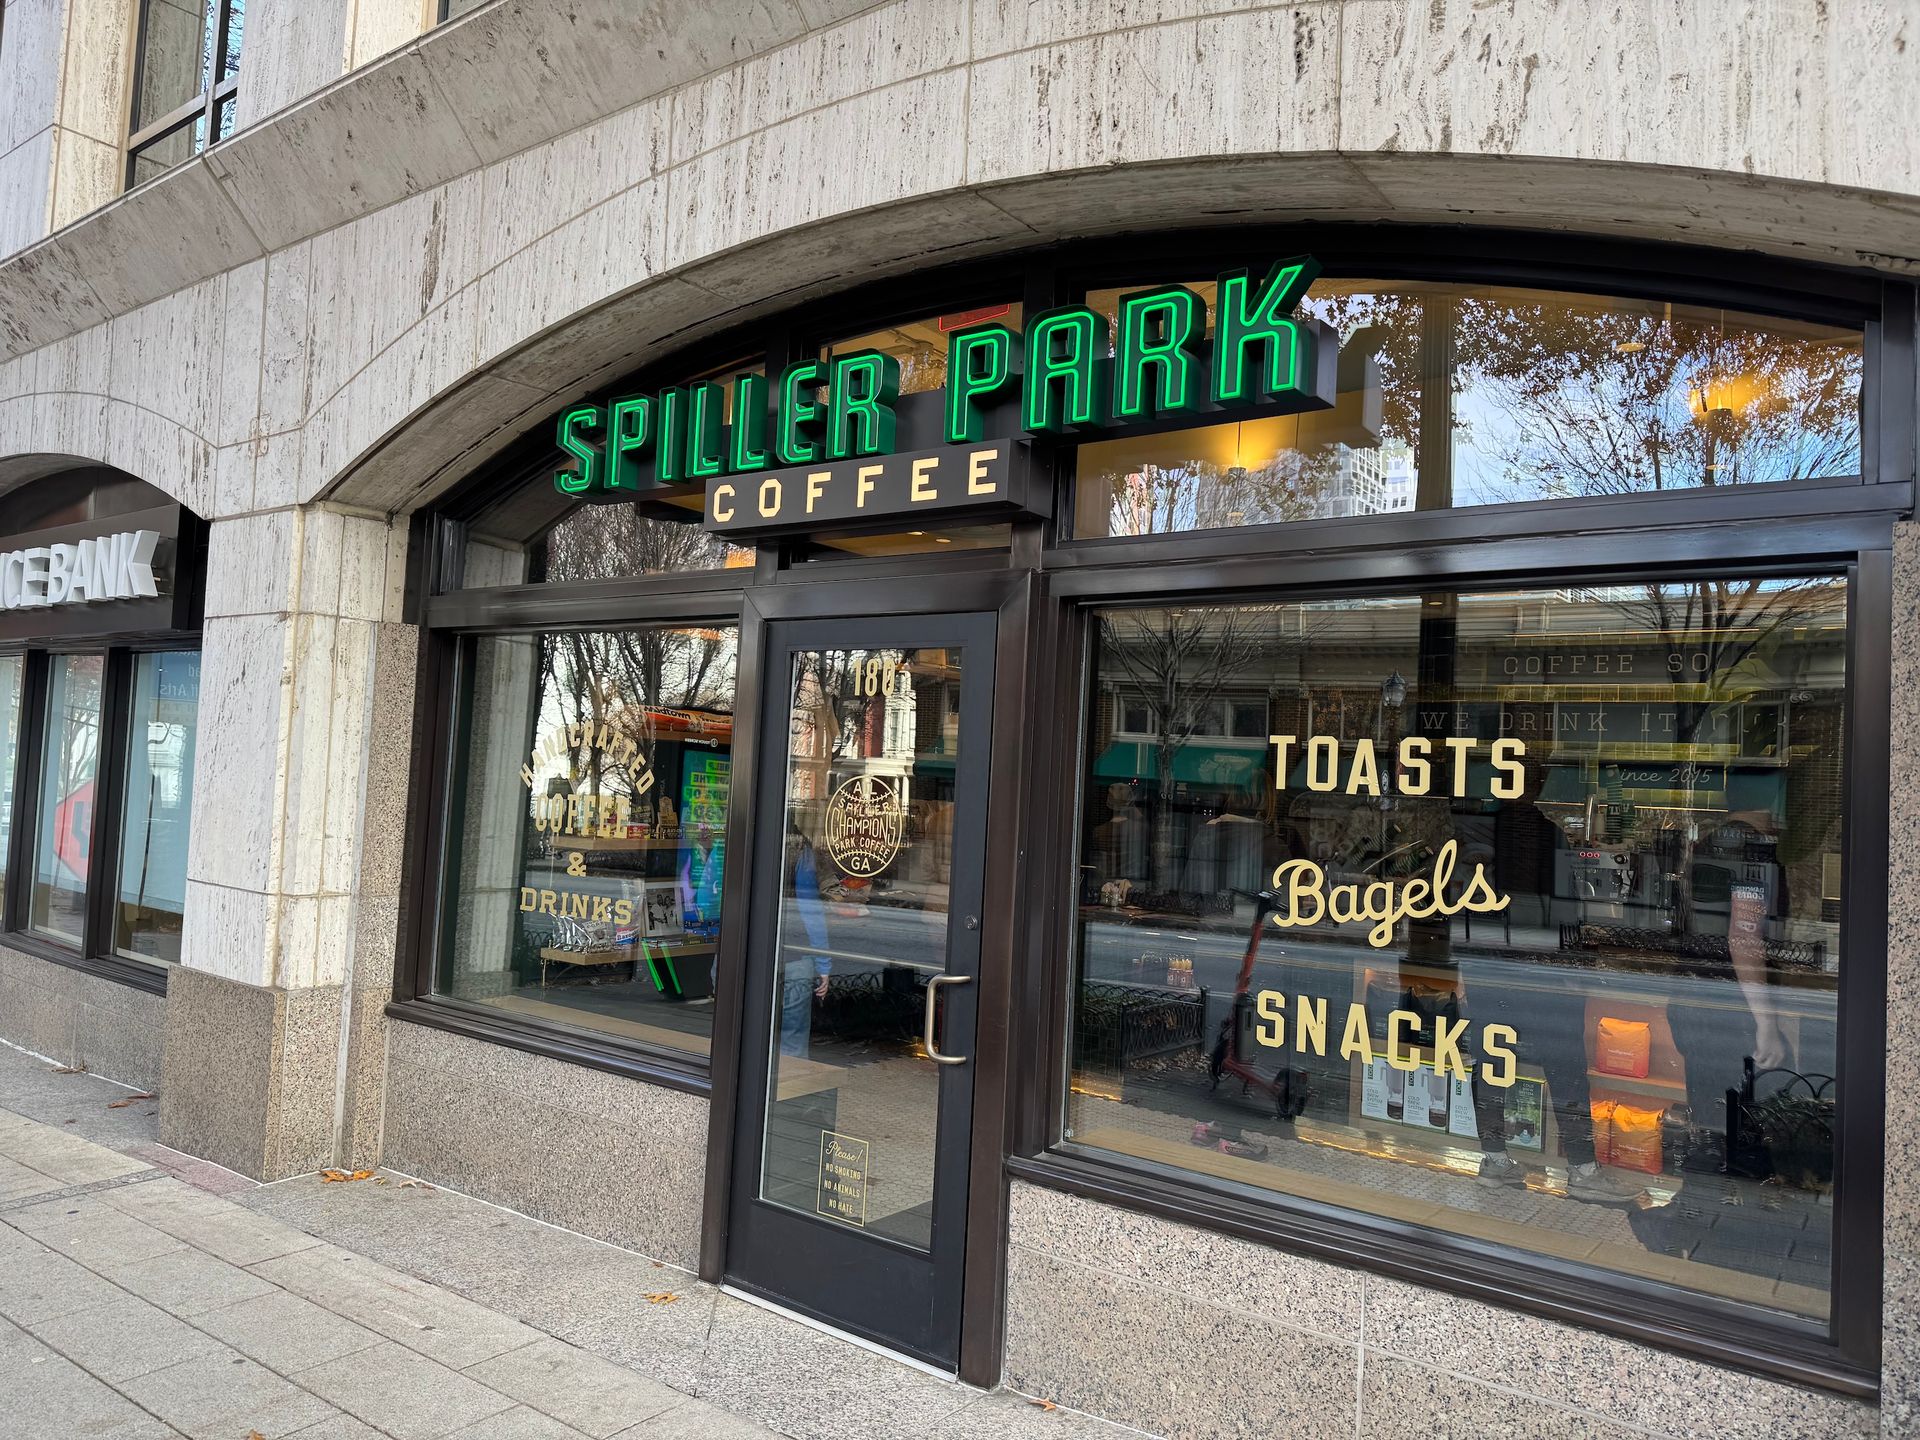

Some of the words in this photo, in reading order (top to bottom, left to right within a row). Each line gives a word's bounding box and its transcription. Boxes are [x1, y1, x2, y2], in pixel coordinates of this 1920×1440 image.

[554, 349, 899, 497] SPILLER
[946, 254, 1322, 444] PARK
[713, 448, 1001, 524] COFFEE
[47, 530, 160, 604] BANK
[1503, 653, 1634, 676] COFFEE
[1420, 711, 1469, 730] WE
[1499, 711, 1608, 732] DRINK
[519, 720, 655, 795] HANDCRAFTED
[1269, 735, 1526, 799] TOASTS
[853, 781, 878, 795] AL
[1618, 768, 1663, 783] ince
[534, 792, 630, 840] COFFEE
[830, 806, 896, 847] CHAMPIONS
[834, 837, 856, 854] PARK
[860, 837, 890, 859] COFFEE
[566, 851, 587, 878] &
[850, 856, 871, 872] GA
[519, 886, 633, 926] DRINKS
[1272, 839, 1512, 949] Bagels
[1256, 989, 1518, 1088] SNACKS
[825, 1140, 864, 1162] Please!
[825, 1162, 834, 1172] NO
[834, 1165, 861, 1181] SMOKING
[823, 1178, 832, 1190] NO
[833, 1182, 861, 1198] ANIMALS
[828, 1198, 837, 1209] NO
[837, 1201, 854, 1214] HATE
